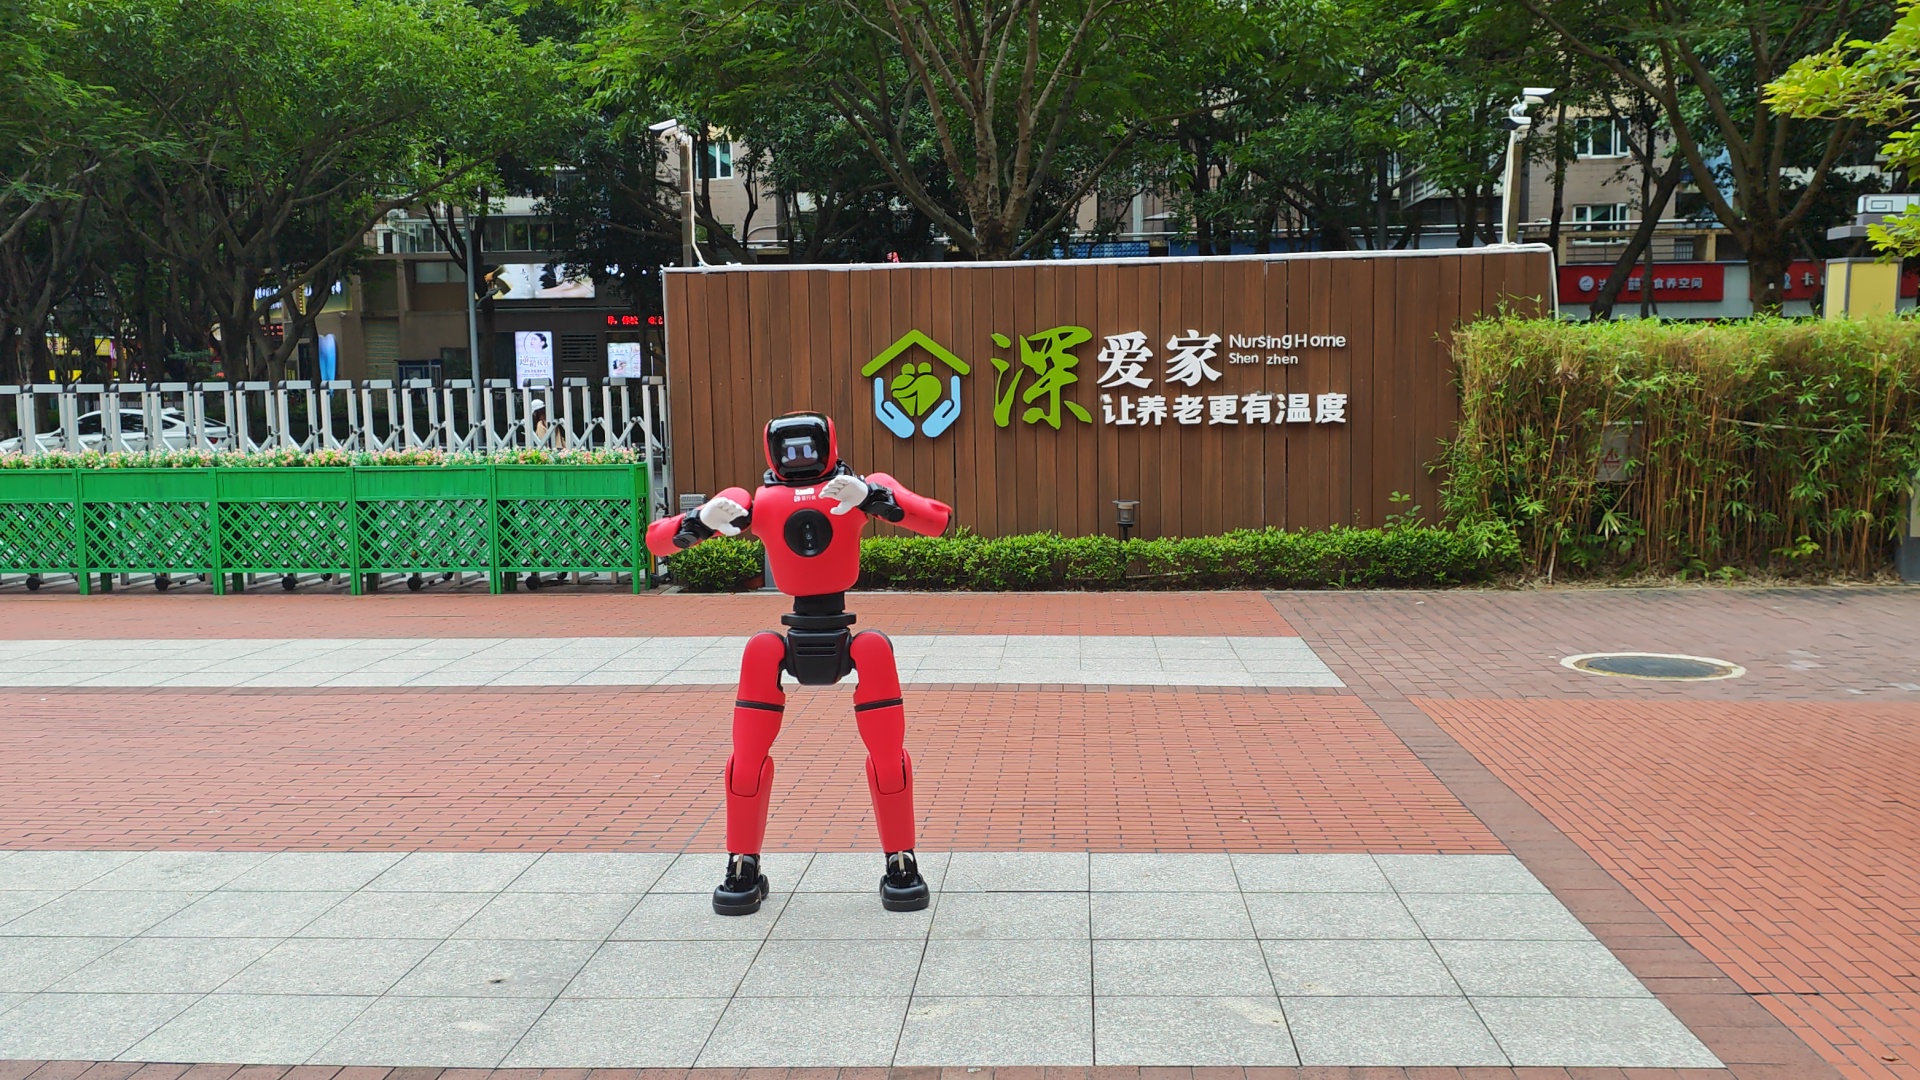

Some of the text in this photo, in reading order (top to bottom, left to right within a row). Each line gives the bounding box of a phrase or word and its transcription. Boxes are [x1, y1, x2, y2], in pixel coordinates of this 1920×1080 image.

[1228, 352, 1299, 365] Shen zhen
[1101, 392, 1347, 425] 让养老更有温度
